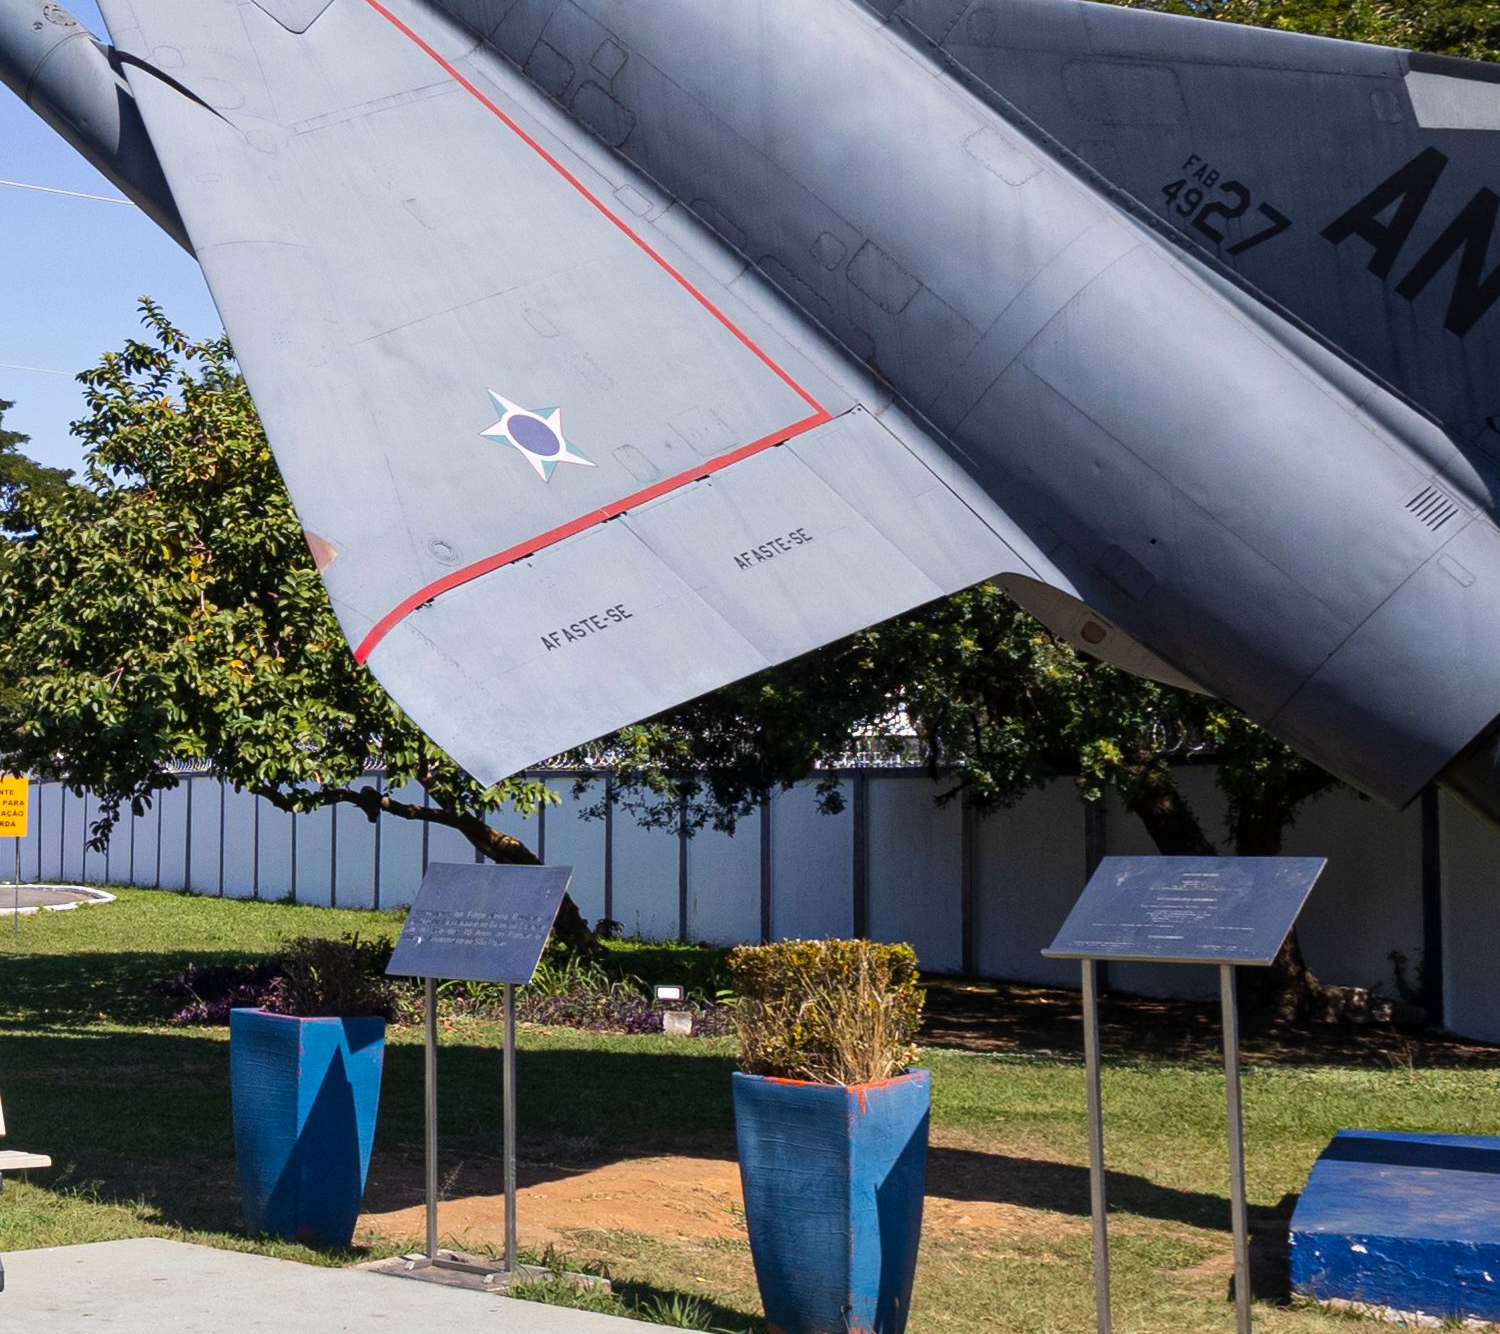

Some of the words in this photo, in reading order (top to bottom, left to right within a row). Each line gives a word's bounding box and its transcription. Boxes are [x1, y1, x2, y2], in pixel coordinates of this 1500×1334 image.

[1182, 154, 1220, 188] FAB
[733, 527, 813, 570] AFASTE-SE
[540, 603, 633, 652] AFASTE-SE
